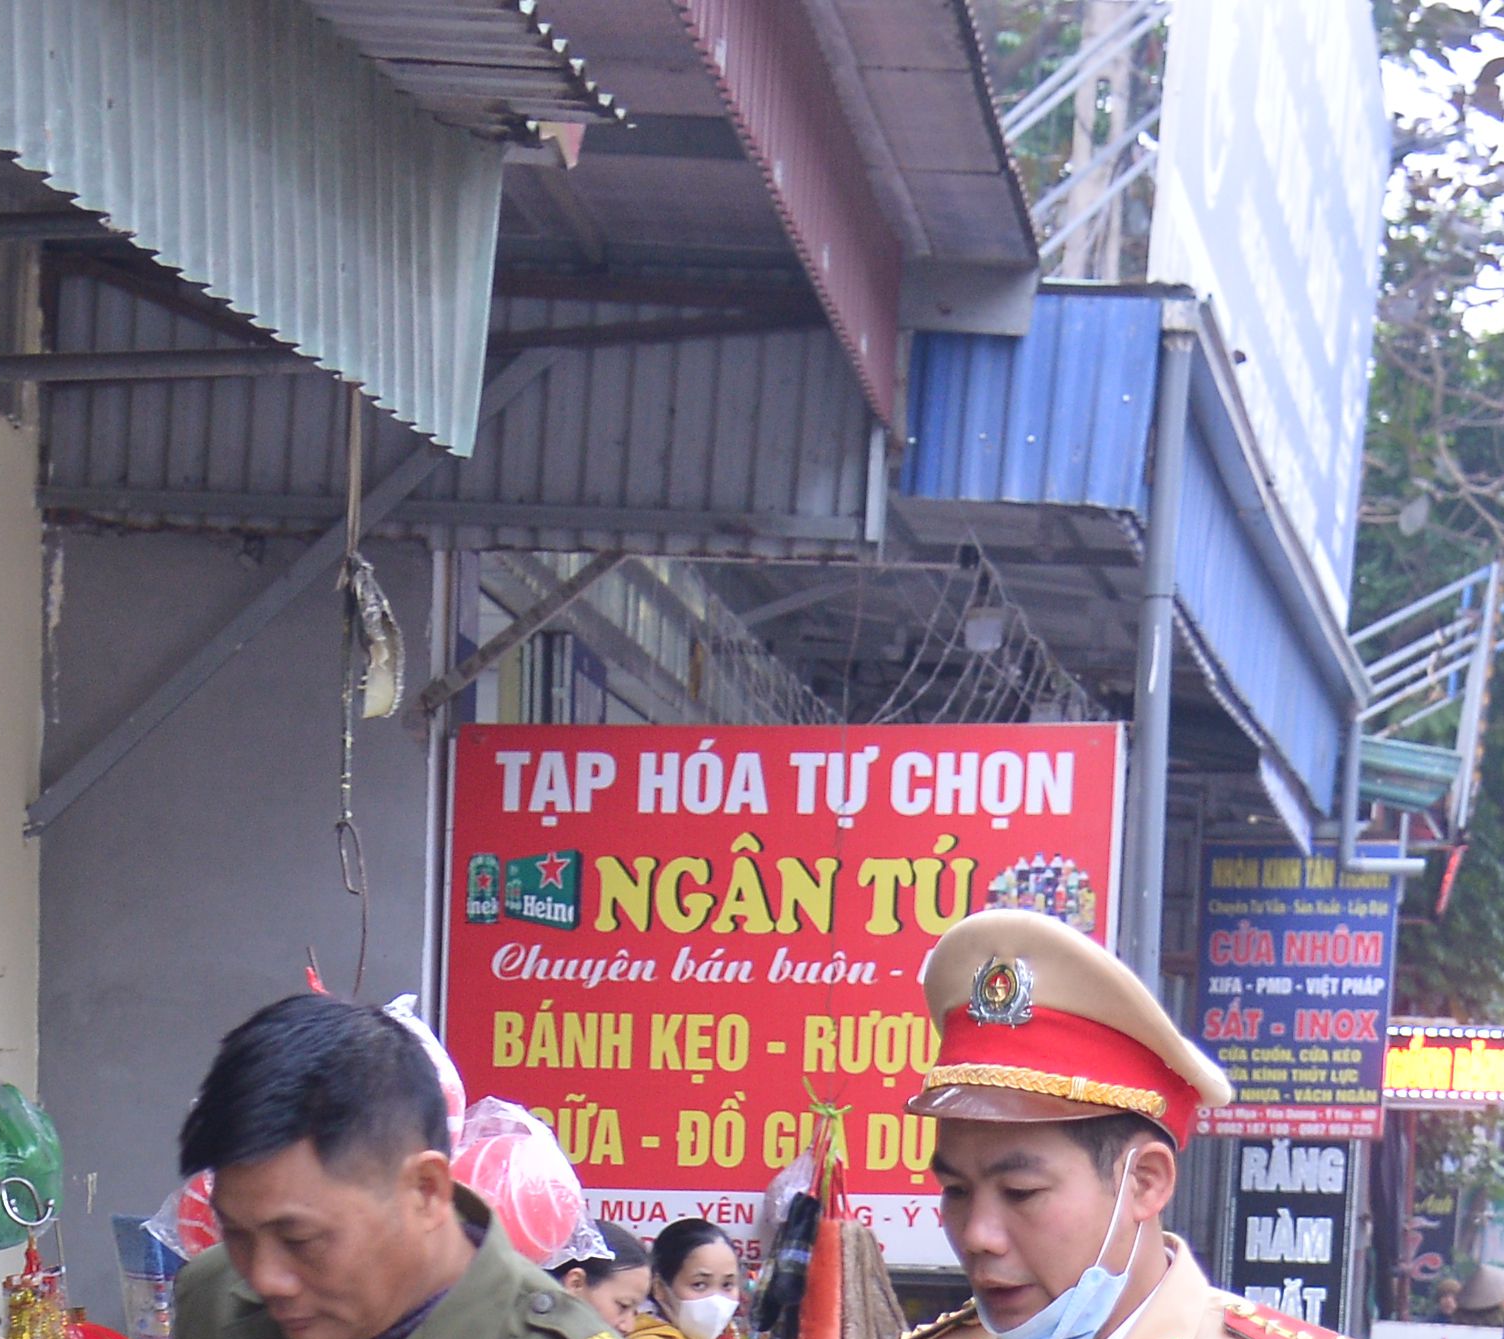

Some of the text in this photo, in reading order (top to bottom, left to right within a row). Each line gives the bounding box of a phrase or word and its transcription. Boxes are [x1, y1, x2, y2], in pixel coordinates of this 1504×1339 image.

[496, 739, 1074, 829] TẠP HÓA TỰ CHỌN
[594, 832, 977, 936] NGÂN TÚ
[492, 941, 656, 989] Chuyên
[671, 944, 754, 985] bán
[769, 948, 878, 985] buôn
[1209, 919, 1384, 967] CỬA NHÔM
[1305, 974, 1339, 998] VIỆT
[1341, 974, 1386, 997] PHÁP
[494, 1000, 632, 1069] BÁNH
[650, 1012, 751, 1084] KẸO
[803, 1009, 939, 1090] RƯỢU
[1203, 996, 1264, 1042] SẮT
[1294, 1008, 1380, 1042] INOX
[676, 1091, 746, 1168] ĐỒ
[866, 1111, 935, 1187] DỤ
[1241, 1139, 1348, 1194] RĂNG
[601, 1199, 668, 1230] MỤA
[697, 1196, 754, 1224] YÊN
[1245, 1208, 1333, 1264] HÀM
